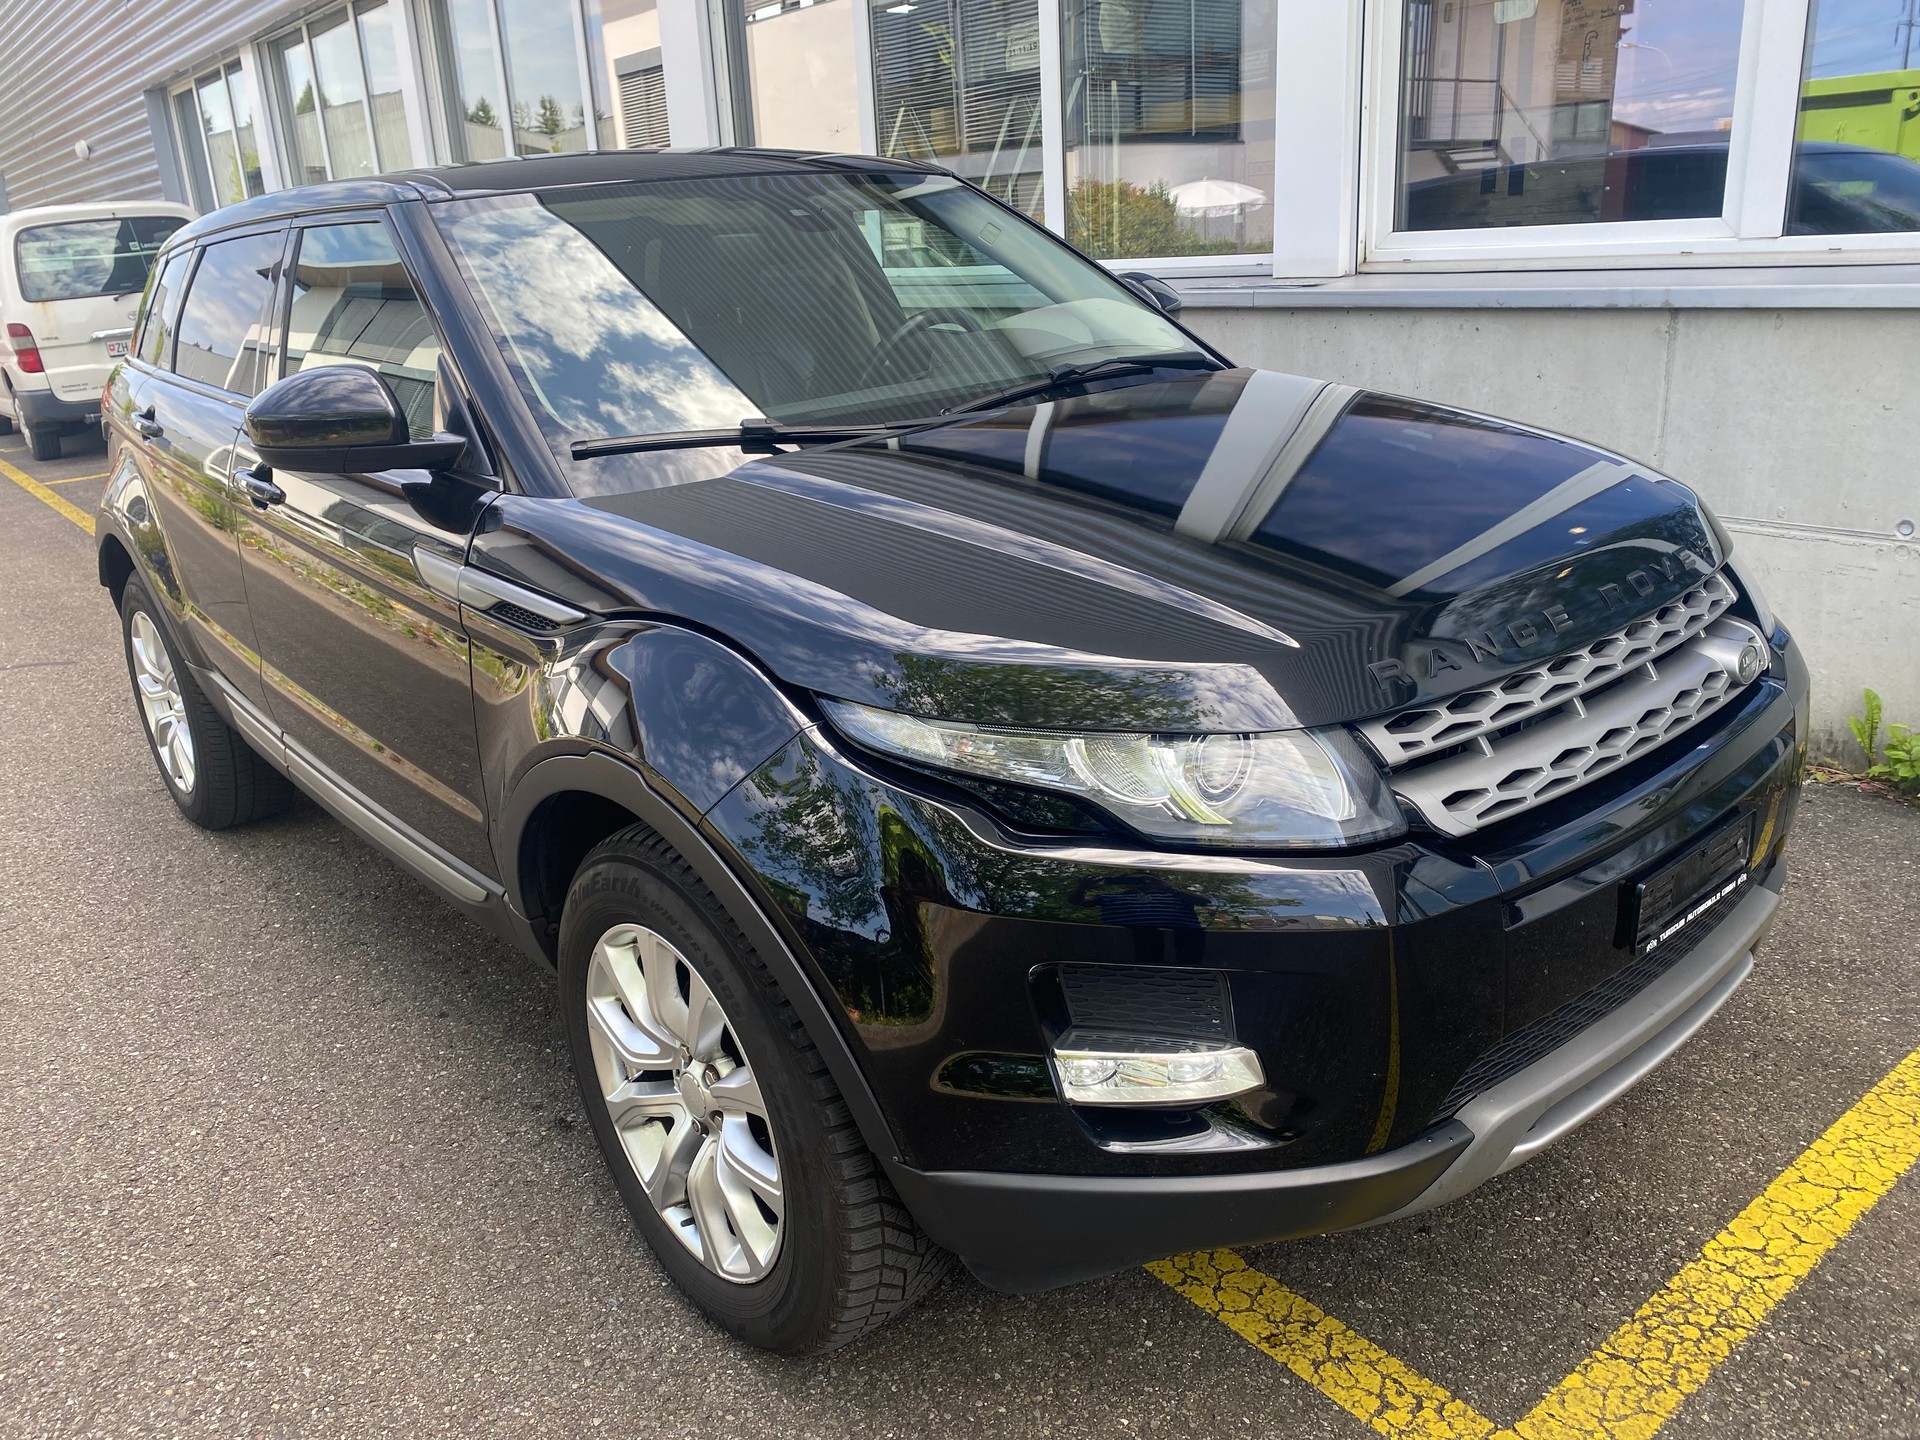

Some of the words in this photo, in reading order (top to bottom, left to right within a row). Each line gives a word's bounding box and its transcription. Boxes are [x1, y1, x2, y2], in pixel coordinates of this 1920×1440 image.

[116, 342, 129, 353] ZH
[1367, 604, 1575, 691] RANGE
[569, 871, 642, 913] BluEarth
[649, 900, 702, 953] WINTER
